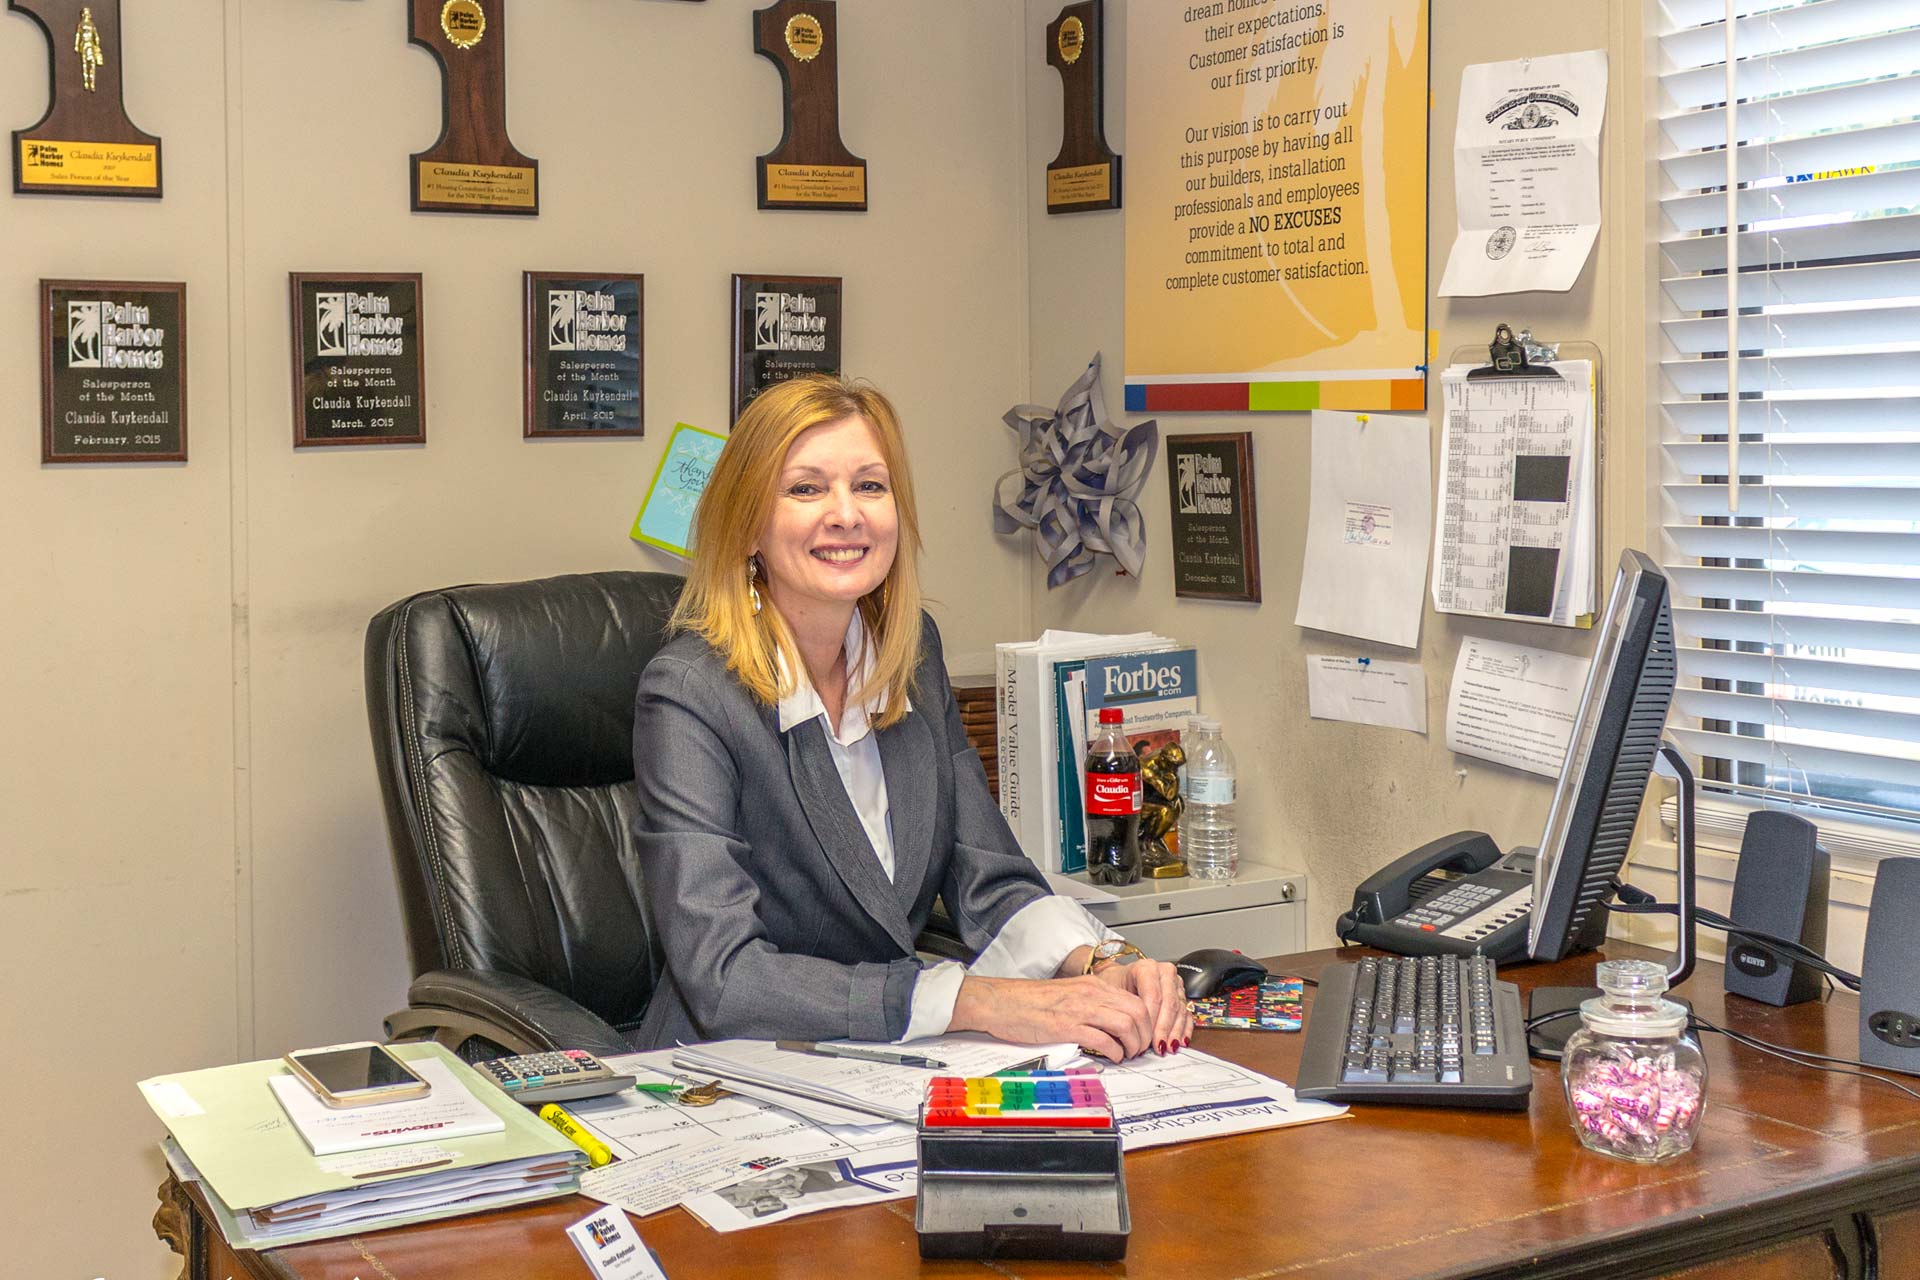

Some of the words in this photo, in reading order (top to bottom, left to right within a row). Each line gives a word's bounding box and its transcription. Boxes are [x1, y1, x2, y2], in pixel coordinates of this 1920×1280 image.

[1184, 3, 1224, 23] dream
[1205, 24, 1235, 42] their
[1238, 3, 1326, 36] expectations.
[1189, 47, 1248, 70] Customer
[1251, 27, 1329, 57] satisfaction
[1332, 23, 1345, 40] is
[1211, 75, 1232, 90] our
[1235, 68, 1262, 86] first
[1266, 55, 1319, 83] priority.
[1185, 128, 1208, 144] Our
[1212, 120, 1250, 140] vision
[1253, 116, 1264, 133] is
[1267, 115, 1281, 130] to
[1284, 108, 1321, 127] carry
[1325, 101, 1348, 119] out
[70, 150, 104, 161] Claudia
[1180, 152, 1204, 169] this
[1207, 145, 1260, 168] purpose
[1263, 139, 1279, 158] by
[1283, 132, 1330, 154] having
[1334, 125, 1353, 145] all
[433, 168, 470, 177] Claudia
[778, 168, 809, 177] Claudia
[1185, 178, 1206, 192] our
[1210, 168, 1265, 190] builders,
[1268, 155, 1346, 181] installation
[1174, 193, 1254, 221] professionals
[1257, 188, 1282, 207] and
[1286, 181, 1360, 205] employees
[1189, 220, 1235, 243] provide
[1238, 222, 1246, 235] a
[1249, 215, 1270, 234] NO
[1273, 206, 1342, 231] EXCUSES
[1185, 243, 1263, 265] commitment
[1267, 241, 1280, 258] to
[1284, 236, 1314, 255] total
[1318, 233, 1345, 251] and
[1165, 271, 1219, 292] complete
[1223, 266, 1281, 287] customer
[1285, 259, 1369, 281] satisfaction.
[346, 292, 390, 314] Palm
[576, 290, 616, 312] Palm
[780, 293, 816, 313] Palm
[102, 301, 149, 325] Palm
[576, 310, 627, 332] Harbor
[780, 311, 827, 332] Harbor
[347, 313, 404, 335] Harbor
[102, 324, 164, 347] Harbor
[348, 334, 403, 356] Homes
[576, 330, 627, 352] Homes
[780, 330, 826, 352] Homes
[102, 346, 163, 369] Homes
[560, 360, 616, 372] Salesperson
[765, 359, 816, 369] Salesperson
[330, 366, 392, 377] Salesperson
[557, 373, 566, 381] of
[571, 373, 586, 381] the
[591, 373, 619, 381] Month
[761, 371, 771, 380] of
[775, 371, 789, 380] the
[82, 379, 151, 391] Salesperson
[327, 379, 337, 388] of
[343, 378, 360, 388] the
[365, 378, 396, 388] Month
[79, 393, 90, 402] of
[96, 393, 115, 402] the
[120, 393, 155, 402] Month
[313, 396, 351, 410] Claudia
[356, 395, 411, 410] Kuykendall
[543, 390, 578, 402] Claudia
[583, 390, 633, 403] Kuykendall
[65, 411, 106, 424] Claudia
[111, 411, 169, 425] Kuykendall
[332, 419, 366, 430] March,
[371, 418, 394, 427] 2015
[593, 411, 615, 421] 2015
[74, 435, 130, 446] February,
[135, 435, 161, 445] 2015
[1195, 453, 1222, 474] Palm
[1196, 473, 1232, 494] Harbor
[1197, 493, 1232, 514] Homes
[1104, 662, 1182, 696] Forbes
[1008, 669, 1017, 717] Model
[1008, 724, 1019, 767] Value
[1010, 772, 1020, 819] Guide
[1096, 784, 1129, 794] Claudia
[373, 1122, 444, 1136] Blevins
[1118, 1104, 1288, 1137] Manufactured
